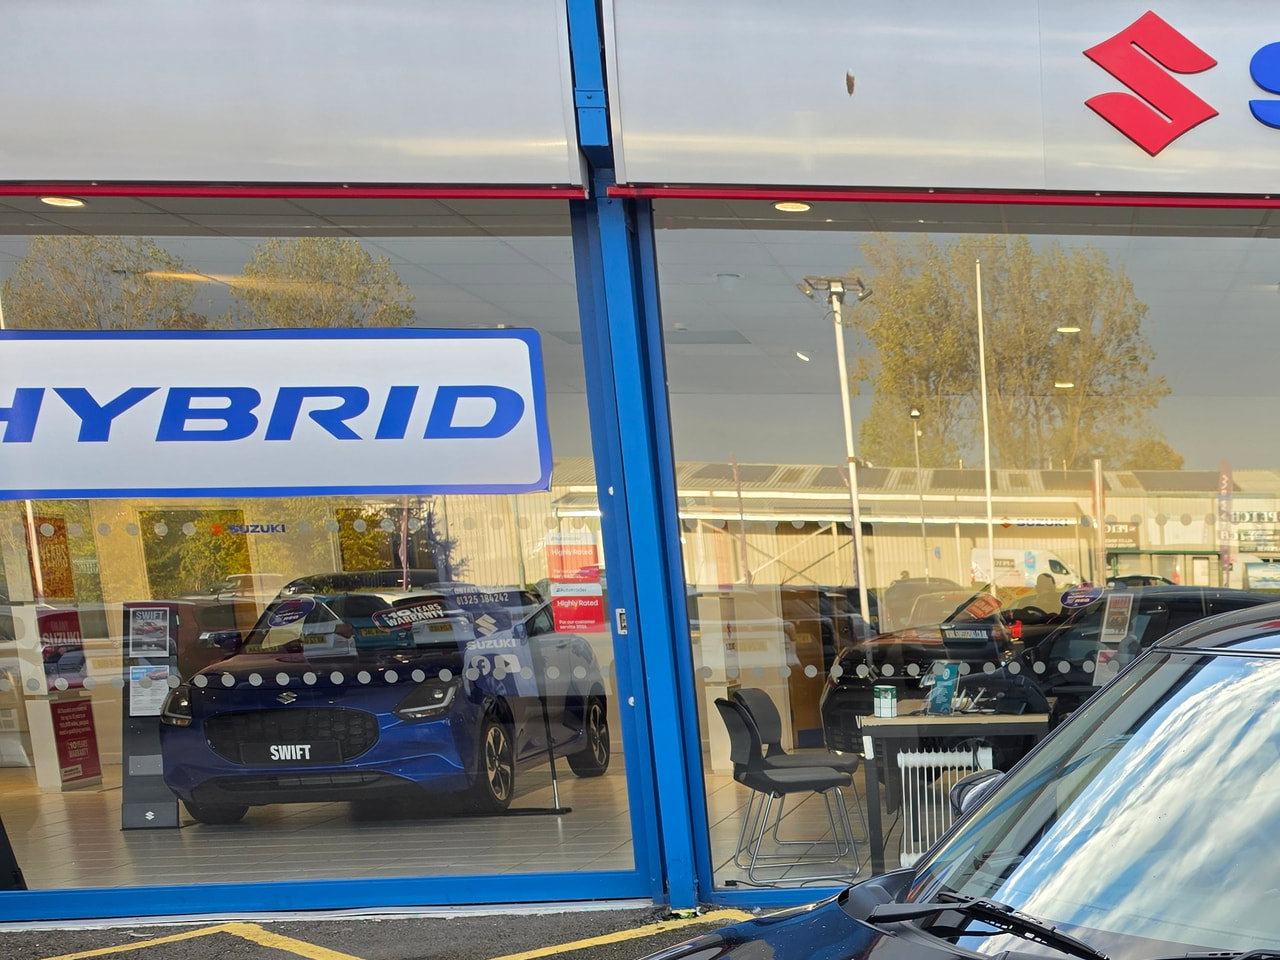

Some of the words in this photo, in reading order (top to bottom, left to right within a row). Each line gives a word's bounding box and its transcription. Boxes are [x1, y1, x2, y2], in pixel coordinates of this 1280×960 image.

[228, 524, 286, 533] SUZUKI
[410, 603, 442, 616] YEARS
[557, 600, 578, 608] Highly
[136, 611, 164, 620] SWIFT
[386, 610, 444, 627] WARRANTY
[42, 631, 81, 646] SUZUKI
[466, 638, 517, 650] SUZUKI
[270, 744, 311, 760] SWIFT
